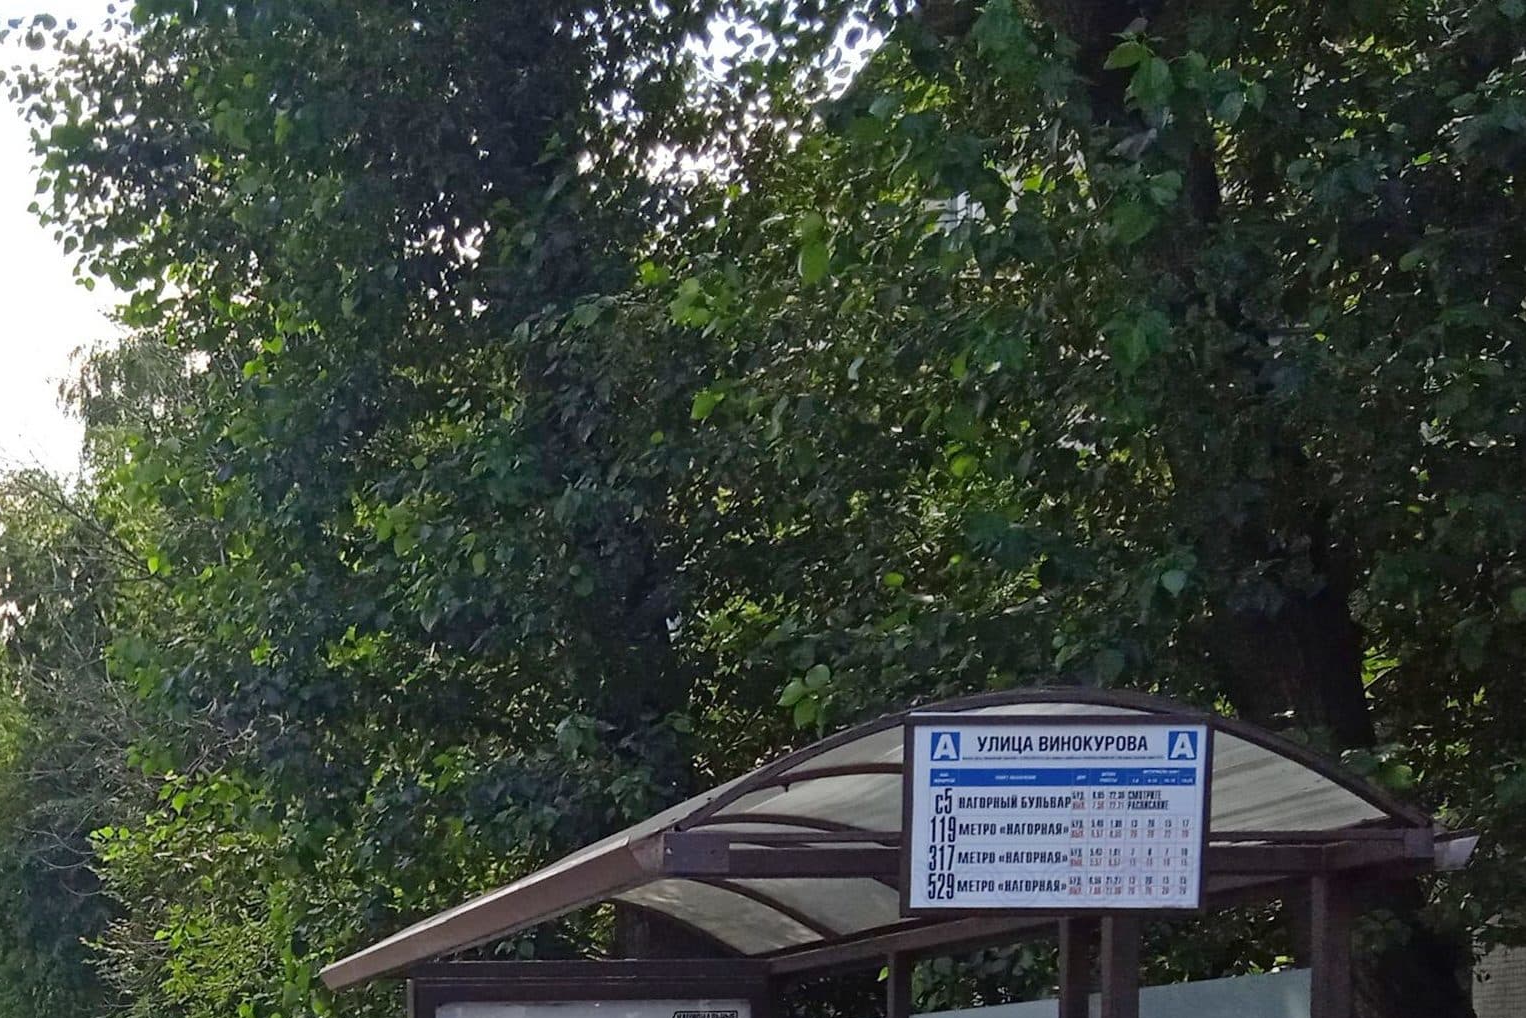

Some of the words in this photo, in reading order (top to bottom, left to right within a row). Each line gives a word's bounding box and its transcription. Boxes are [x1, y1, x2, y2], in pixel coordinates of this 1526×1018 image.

[977, 736, 1033, 754] УЛИЦА
[1038, 735, 1148, 752] ВИНОКУРОВА
[959, 794, 1018, 809] НАГОРНЫЙ
[1021, 796, 1072, 809] БУЛЬВАР
[931, 816, 956, 843] 119
[959, 823, 997, 836] МЕТРО
[999, 823, 1069, 836] «НАГОРНАЯ»
[928, 844, 955, 871] 317
[958, 852, 996, 864] МЕТРО
[998, 851, 1068, 864] «НАГОРНАЯ»
[928, 873, 955, 900] 529
[957, 880, 994, 892] МЕТРО
[998, 880, 1067, 892] «НАГОРНАЯ»
